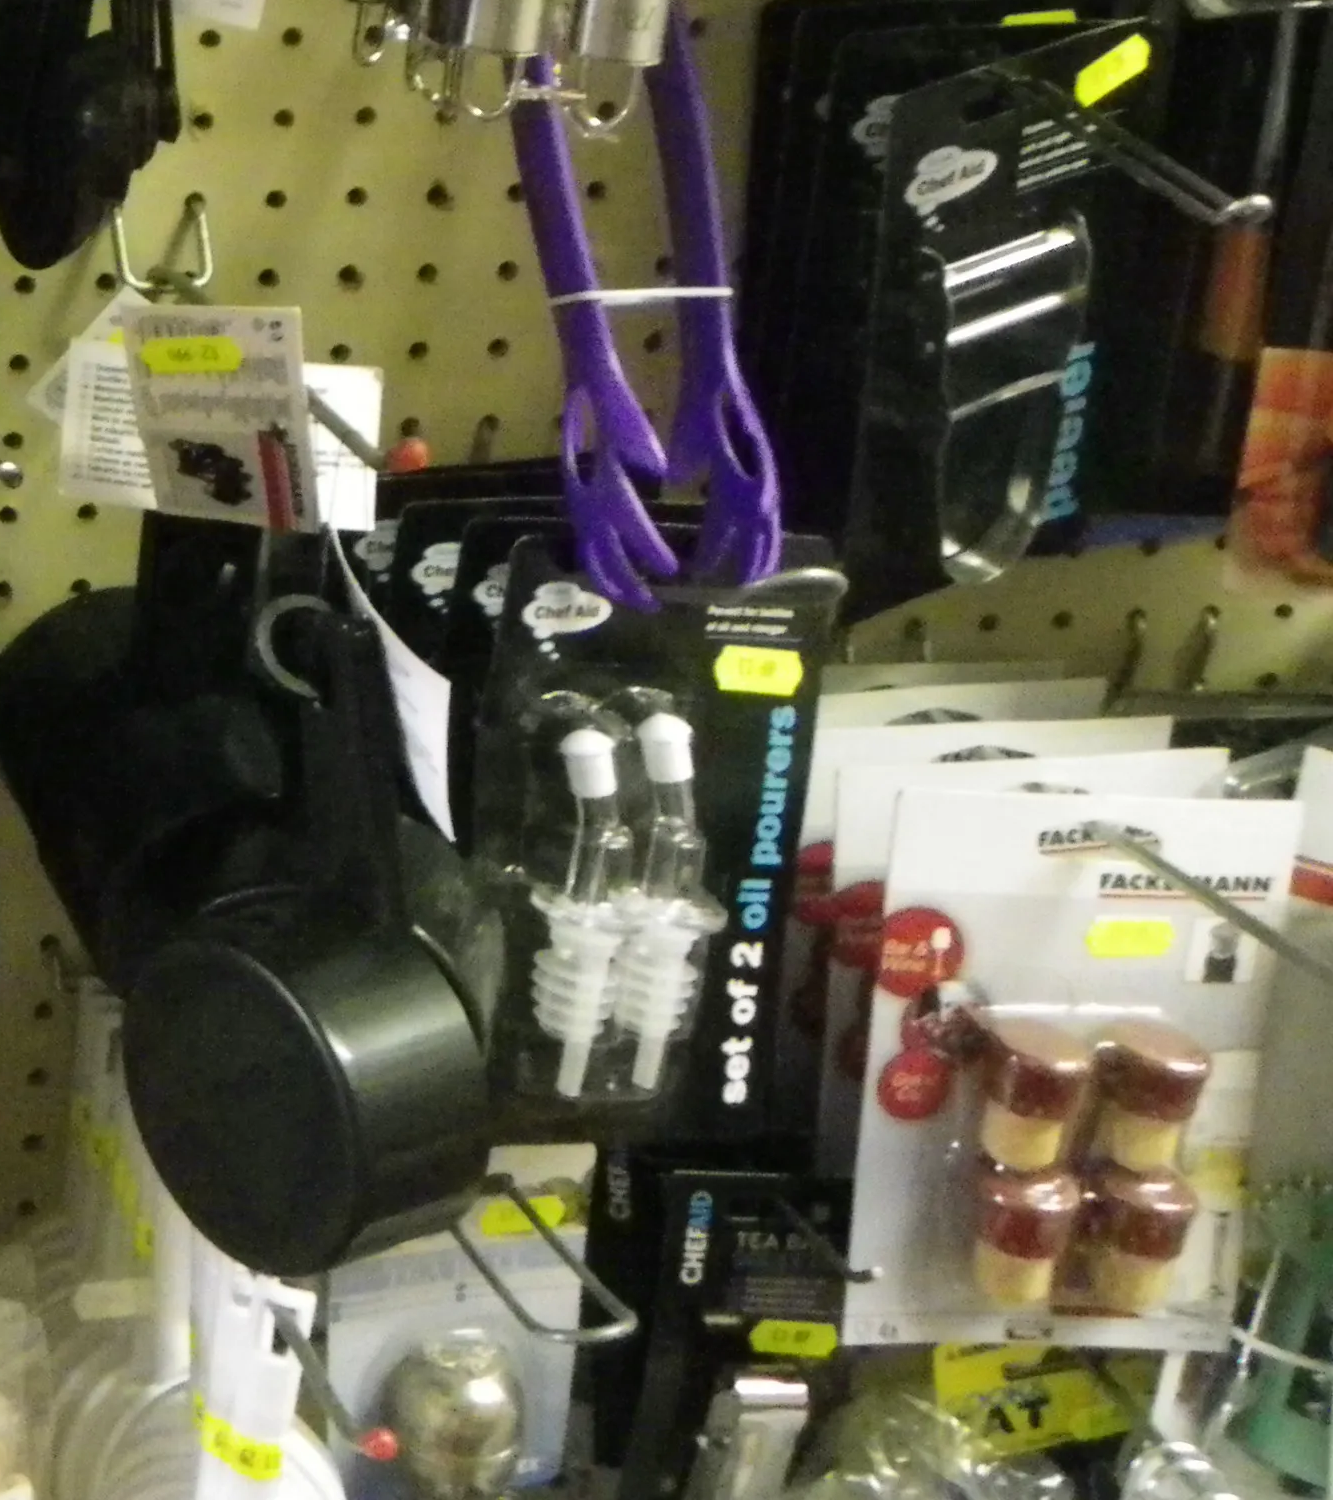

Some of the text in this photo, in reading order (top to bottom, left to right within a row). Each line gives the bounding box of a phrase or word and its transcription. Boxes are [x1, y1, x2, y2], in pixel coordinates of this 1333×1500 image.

[750, 704, 798, 868] pourers
[740, 878, 773, 930] oil
[732, 941, 764, 968] 2
[727, 977, 762, 1026] of
[722, 1033, 755, 1106] set
